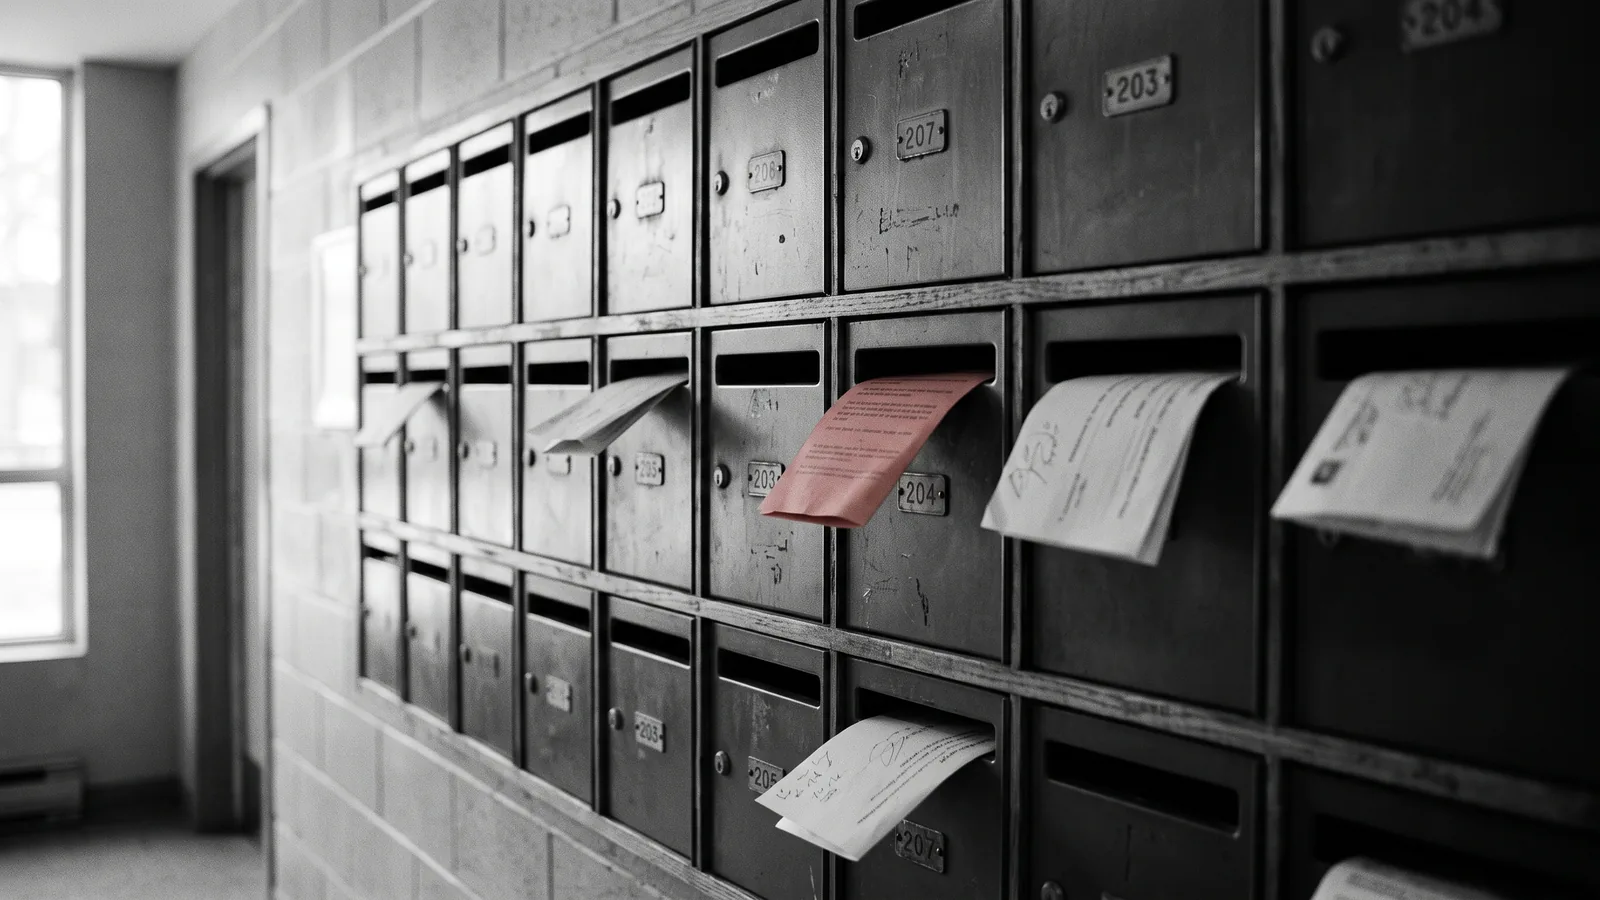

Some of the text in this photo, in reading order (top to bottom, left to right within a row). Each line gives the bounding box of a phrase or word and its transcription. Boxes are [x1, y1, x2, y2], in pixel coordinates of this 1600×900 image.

[1117, 67, 1159, 103] 203
[905, 121, 935, 150] 207
[754, 469, 775, 489] 203
[906, 481, 936, 506] 204
[640, 721, 658, 743] 203
[903, 829, 936, 860] 207
